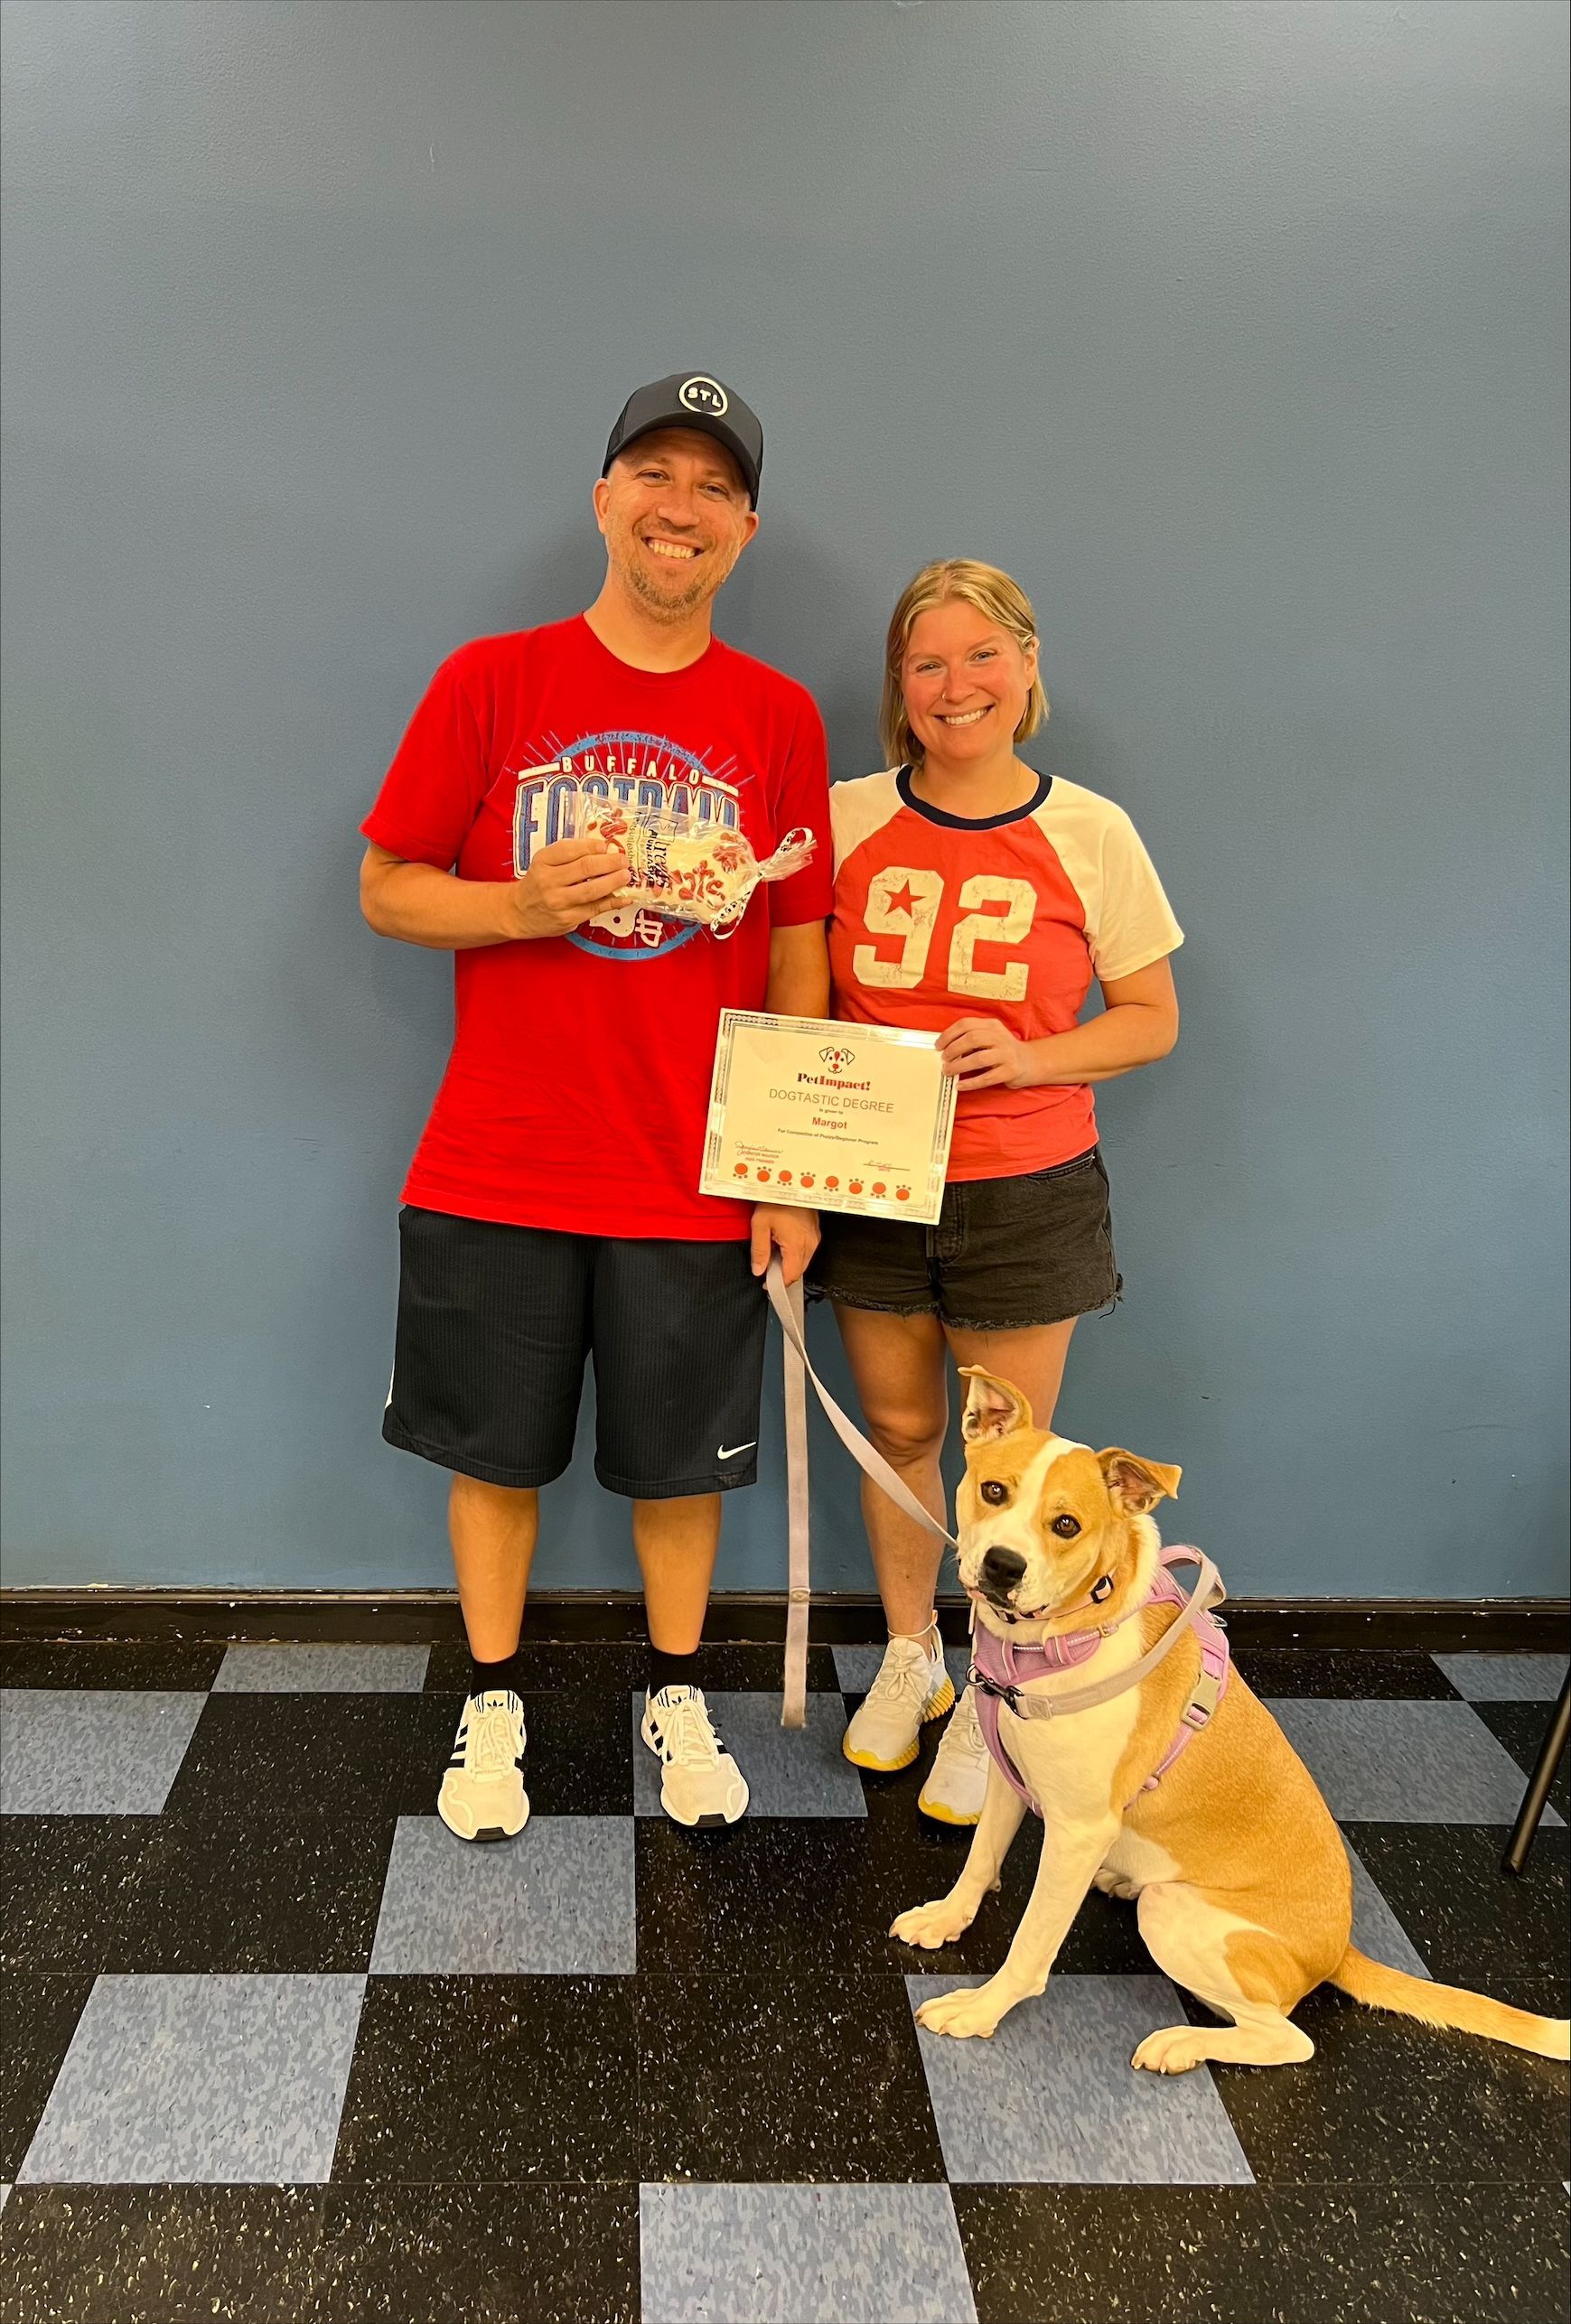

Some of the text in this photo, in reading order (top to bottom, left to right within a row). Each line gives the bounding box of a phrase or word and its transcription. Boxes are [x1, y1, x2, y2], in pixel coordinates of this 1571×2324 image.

[687, 387, 722, 408] STL
[561, 755, 701, 786] BUFFALO
[852, 865, 1038, 1003] 92
[797, 1072, 871, 1091] PetImpact!
[769, 1088, 894, 1113] DOGTASTIC DEGREE
[811, 1116, 847, 1130] Margot
